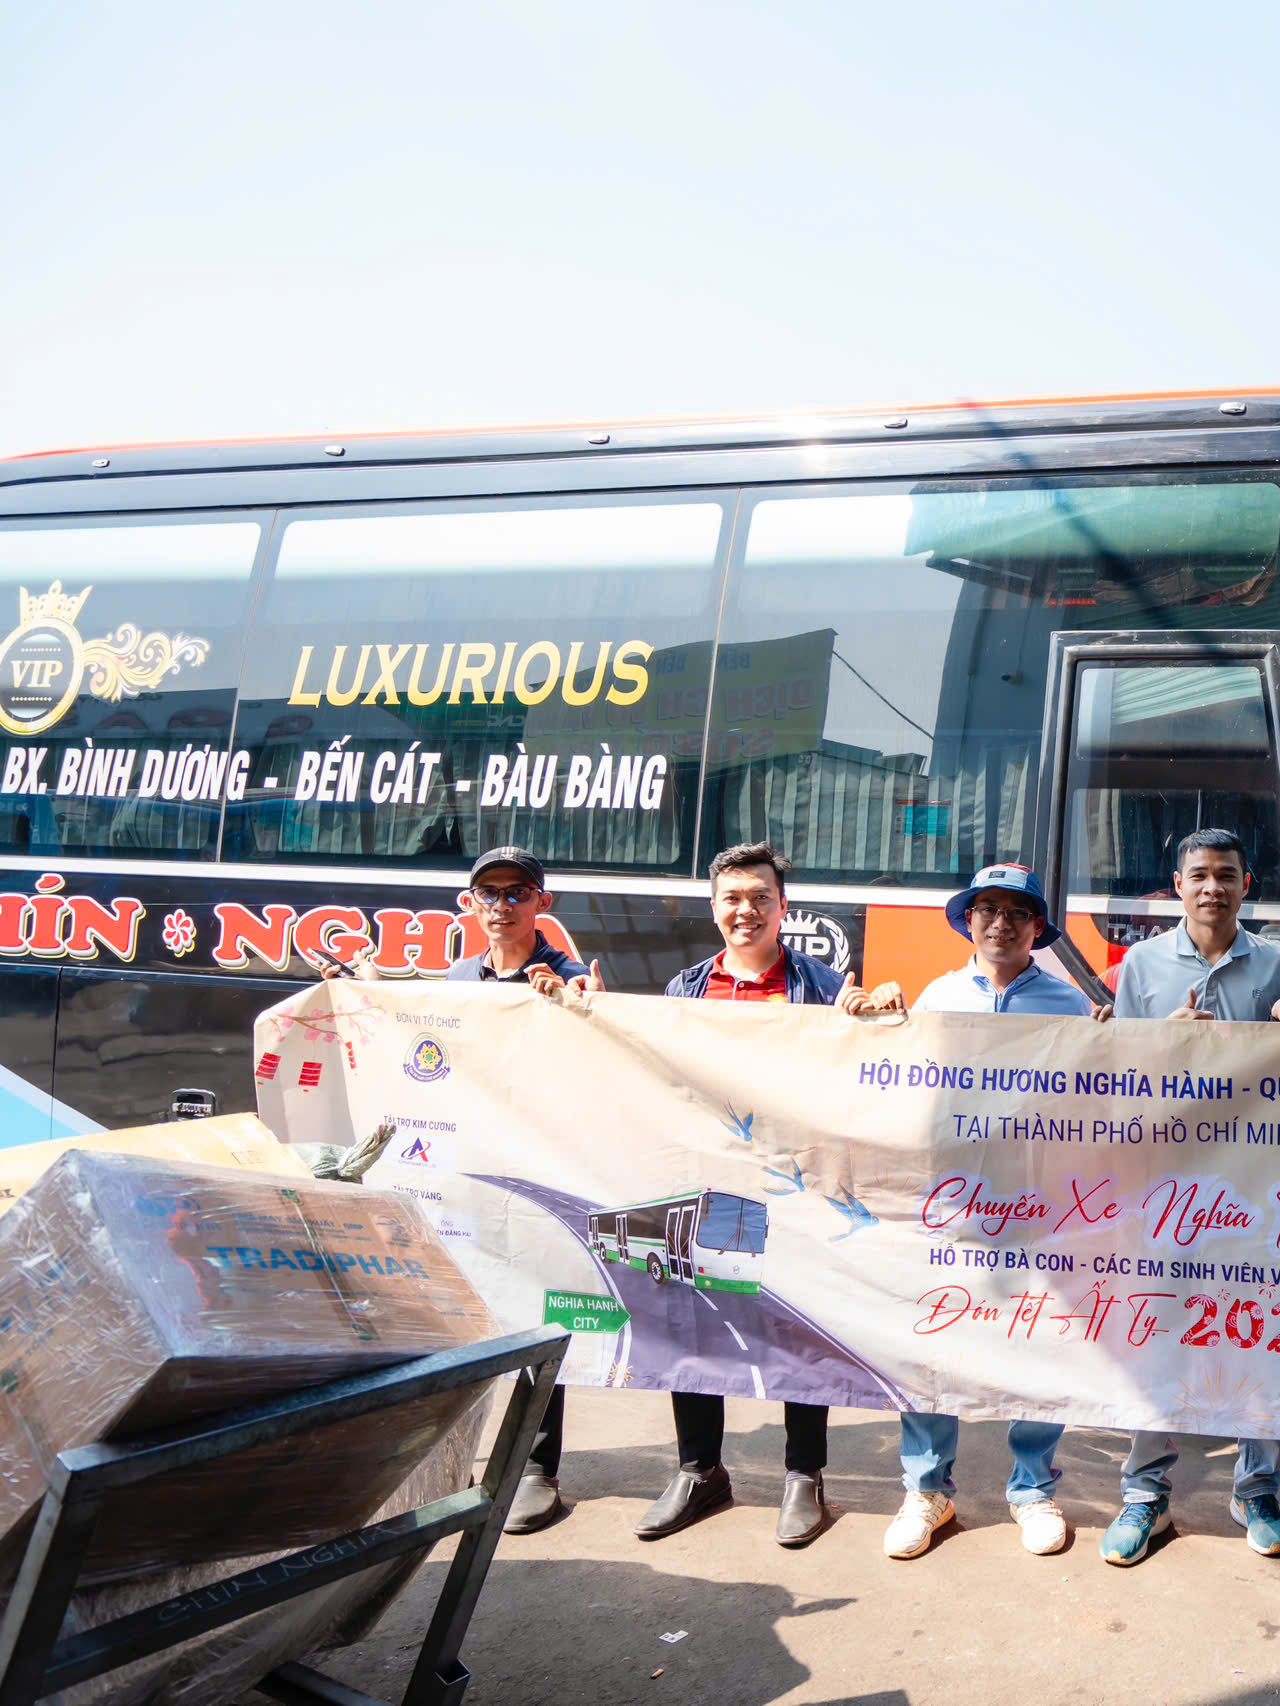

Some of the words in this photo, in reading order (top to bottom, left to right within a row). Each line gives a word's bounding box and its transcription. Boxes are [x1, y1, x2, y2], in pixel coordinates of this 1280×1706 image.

[10, 659, 63, 689] VIP
[288, 640, 656, 708] LUXURIOUS
[2, 747, 48, 795] BX.
[57, 738, 133, 797] BÌNH
[141, 744, 250, 801] DƯƠNG
[299, 735, 364, 802] BẾN
[370, 743, 440, 803] CÁT
[480, 743, 558, 808] BÀU
[564, 743, 666, 810] BÀNG
[1107, 923, 1176, 941] THA
[396, 1012, 412, 1024] ĐƠN
[436, 1016, 461, 1029] CHỨC
[859, 1059, 899, 1088] HỘI
[907, 1057, 974, 1090] ĐỒNG
[982, 1064, 1067, 1094] HƯƠNG
[1074, 1066, 1153, 1098] NGHĨA
[1161, 1069, 1233, 1100] HÀNH
[397, 1117, 411, 1130] TRỢ
[412, 1119, 427, 1129] KIM
[429, 1121, 457, 1132] CƯƠNG
[953, 1113, 990, 1143] TẠI
[998, 1110, 1083, 1143] THÀNH
[1092, 1114, 1144, 1144] PHỐ
[1152, 1115, 1188, 1145] HỒ
[1196, 1115, 1239, 1145] CHÍ
[420, 1188, 443, 1201] VÀNG
[922, 1176, 1050, 1236] Chuyến
[1053, 1178, 1122, 1234] Xe
[1143, 1180, 1256, 1246] Nghĩa
[930, 1243, 955, 1268] HỖ
[961, 1249, 998, 1272] TRỢ
[1005, 1243, 1031, 1269] BÀ
[1035, 1252, 1073, 1272] CON
[1093, 1250, 1132, 1275] CÁC
[1137, 1258, 1164, 1277] EM
[1170, 1261, 1215, 1281] SINH
[1221, 1260, 1265, 1285] VIÊN
[549, 1296, 585, 1310] NGHIA
[587, 1299, 619, 1313] HANH
[913, 1285, 1003, 1335] Đón
[573, 1317, 600, 1330] CITY
